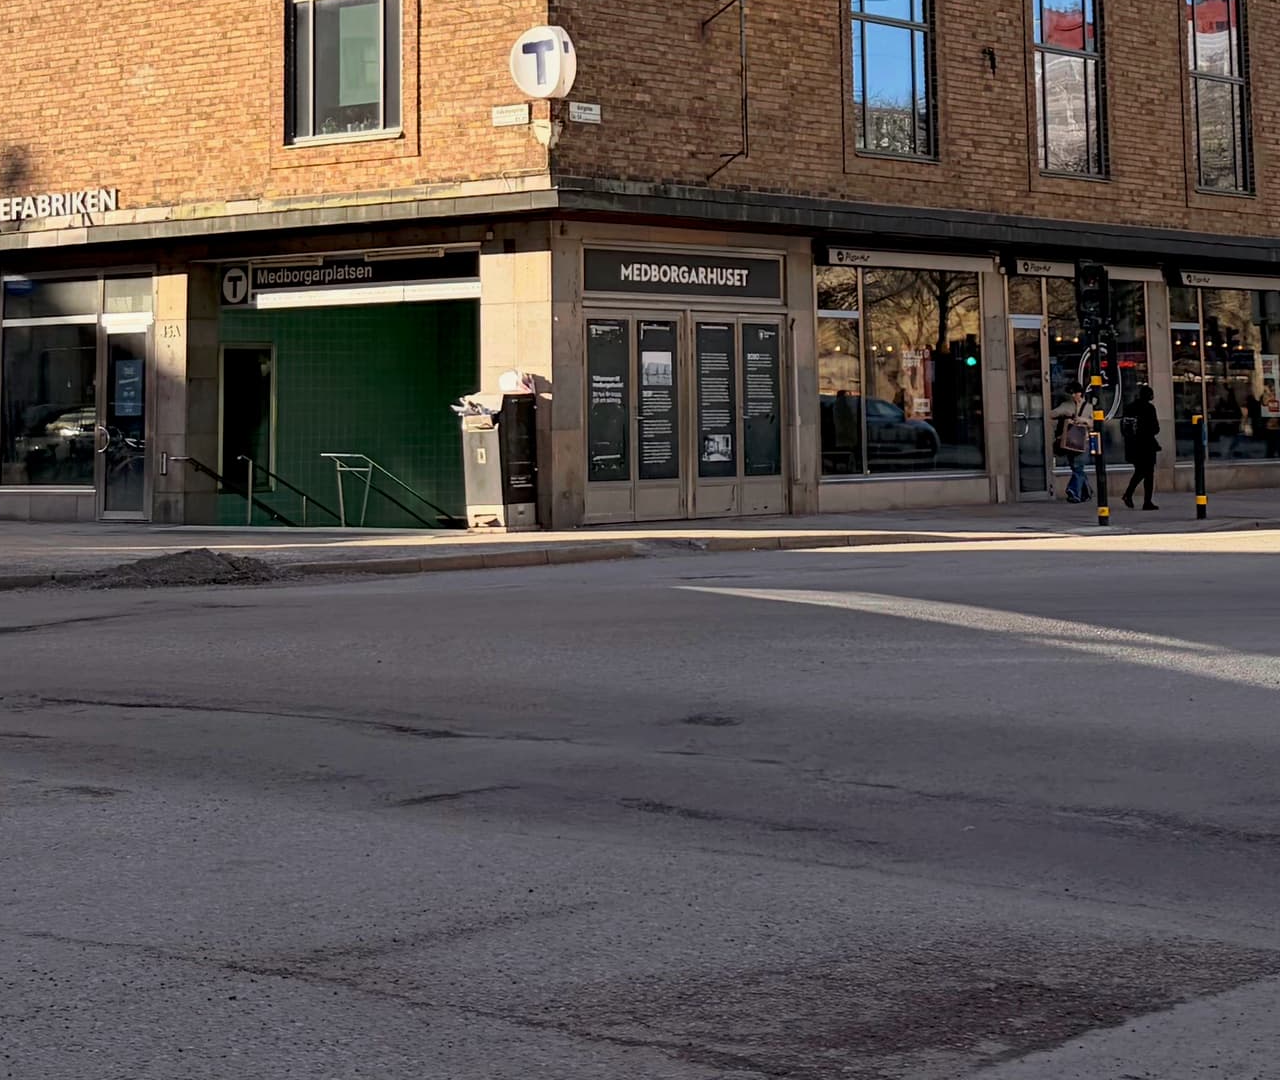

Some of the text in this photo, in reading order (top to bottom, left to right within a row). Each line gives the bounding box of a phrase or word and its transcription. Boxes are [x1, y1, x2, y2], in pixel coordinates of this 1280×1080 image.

[522, 39, 554, 86] T
[227, 275, 243, 299] T
[256, 265, 373, 285] Medborgarplatsen
[620, 263, 749, 287] MEDBORGARHUSET
